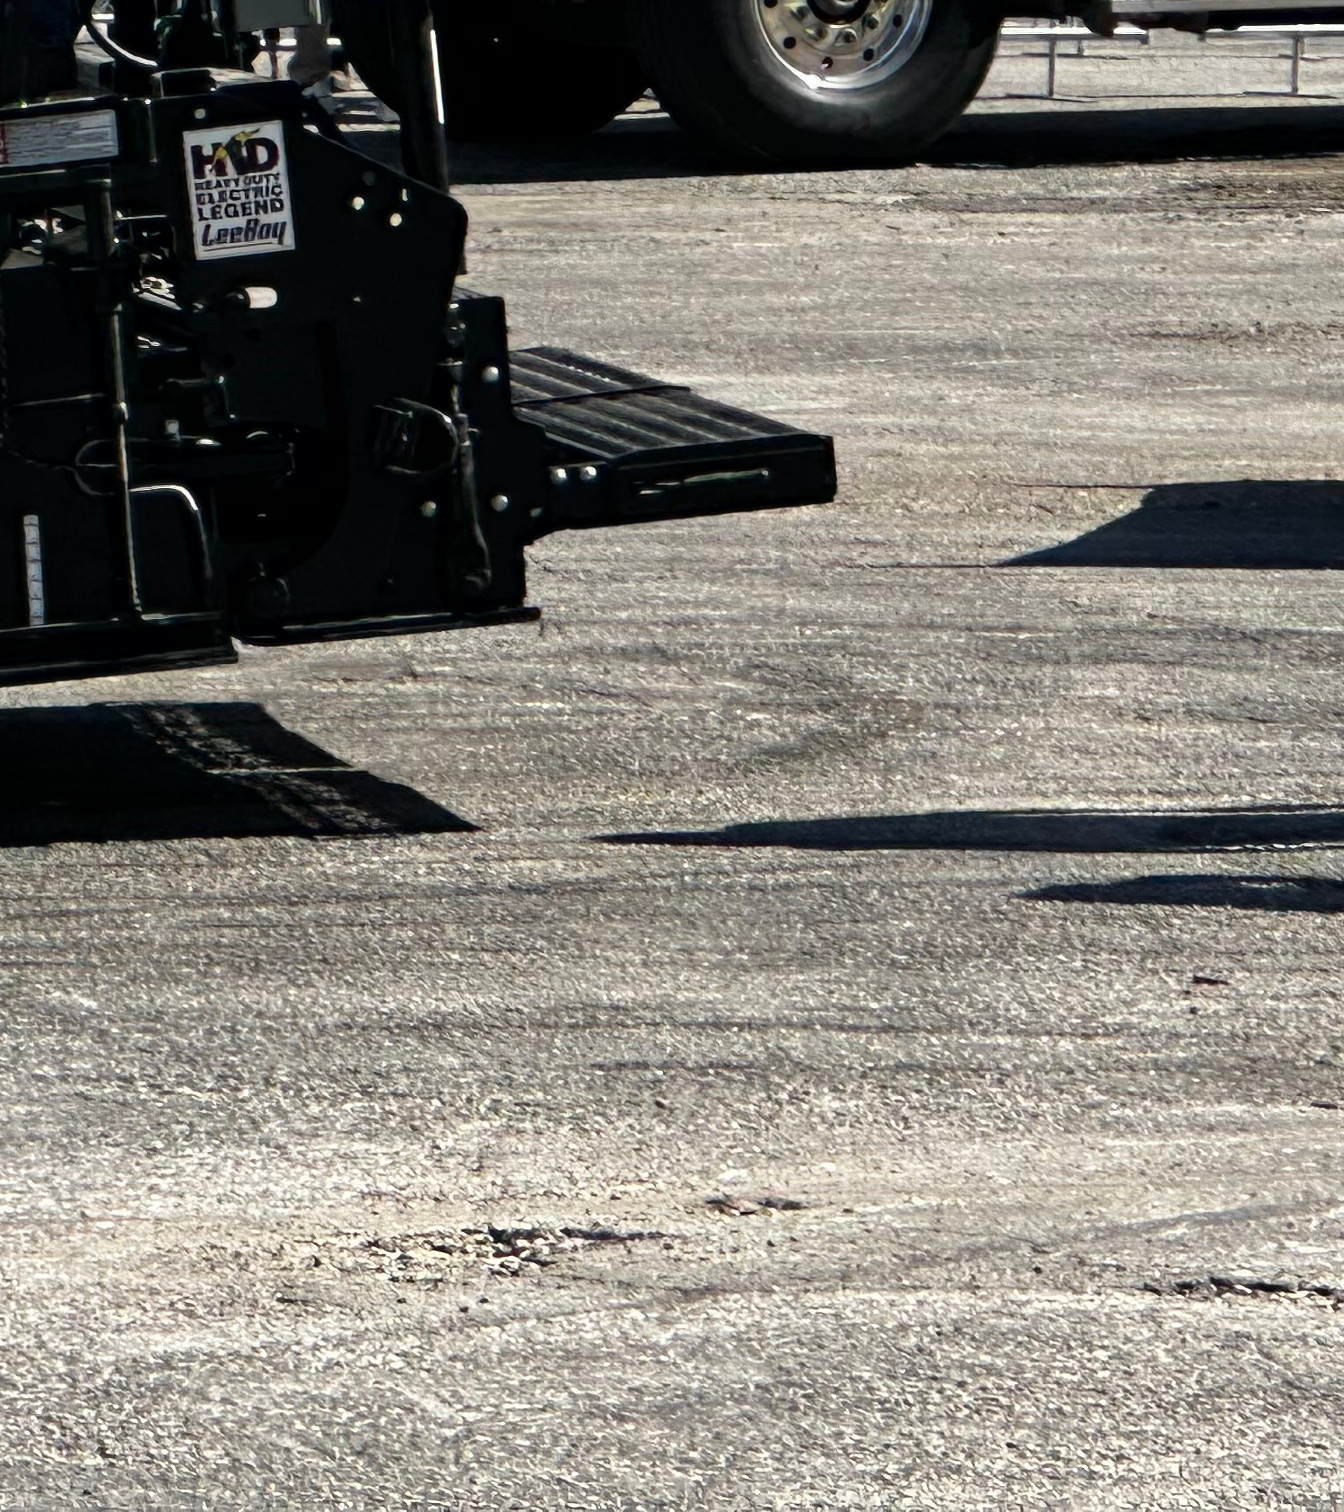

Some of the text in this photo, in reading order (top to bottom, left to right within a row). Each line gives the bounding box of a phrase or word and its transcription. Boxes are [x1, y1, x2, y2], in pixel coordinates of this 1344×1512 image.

[196, 185, 283, 205] ELECTRIC
[198, 198, 284, 222] LEGEND
[202, 218, 288, 246] LeeBoy
